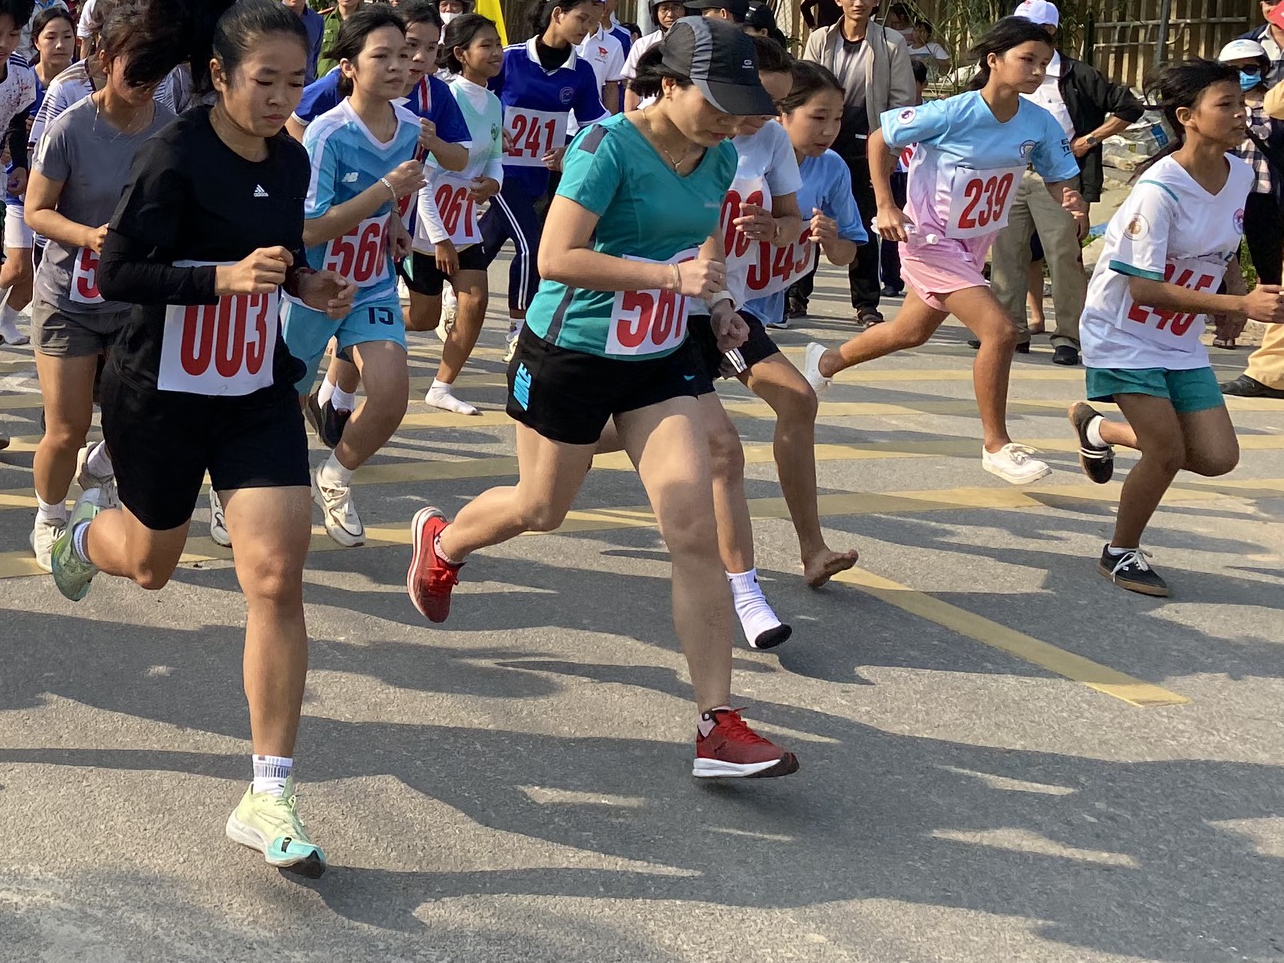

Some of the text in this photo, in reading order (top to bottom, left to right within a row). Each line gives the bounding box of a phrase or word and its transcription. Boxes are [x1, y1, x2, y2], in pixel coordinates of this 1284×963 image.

[508, 114, 556, 158] 241
[957, 172, 1014, 229] 239
[180, 293, 268, 377] 003
